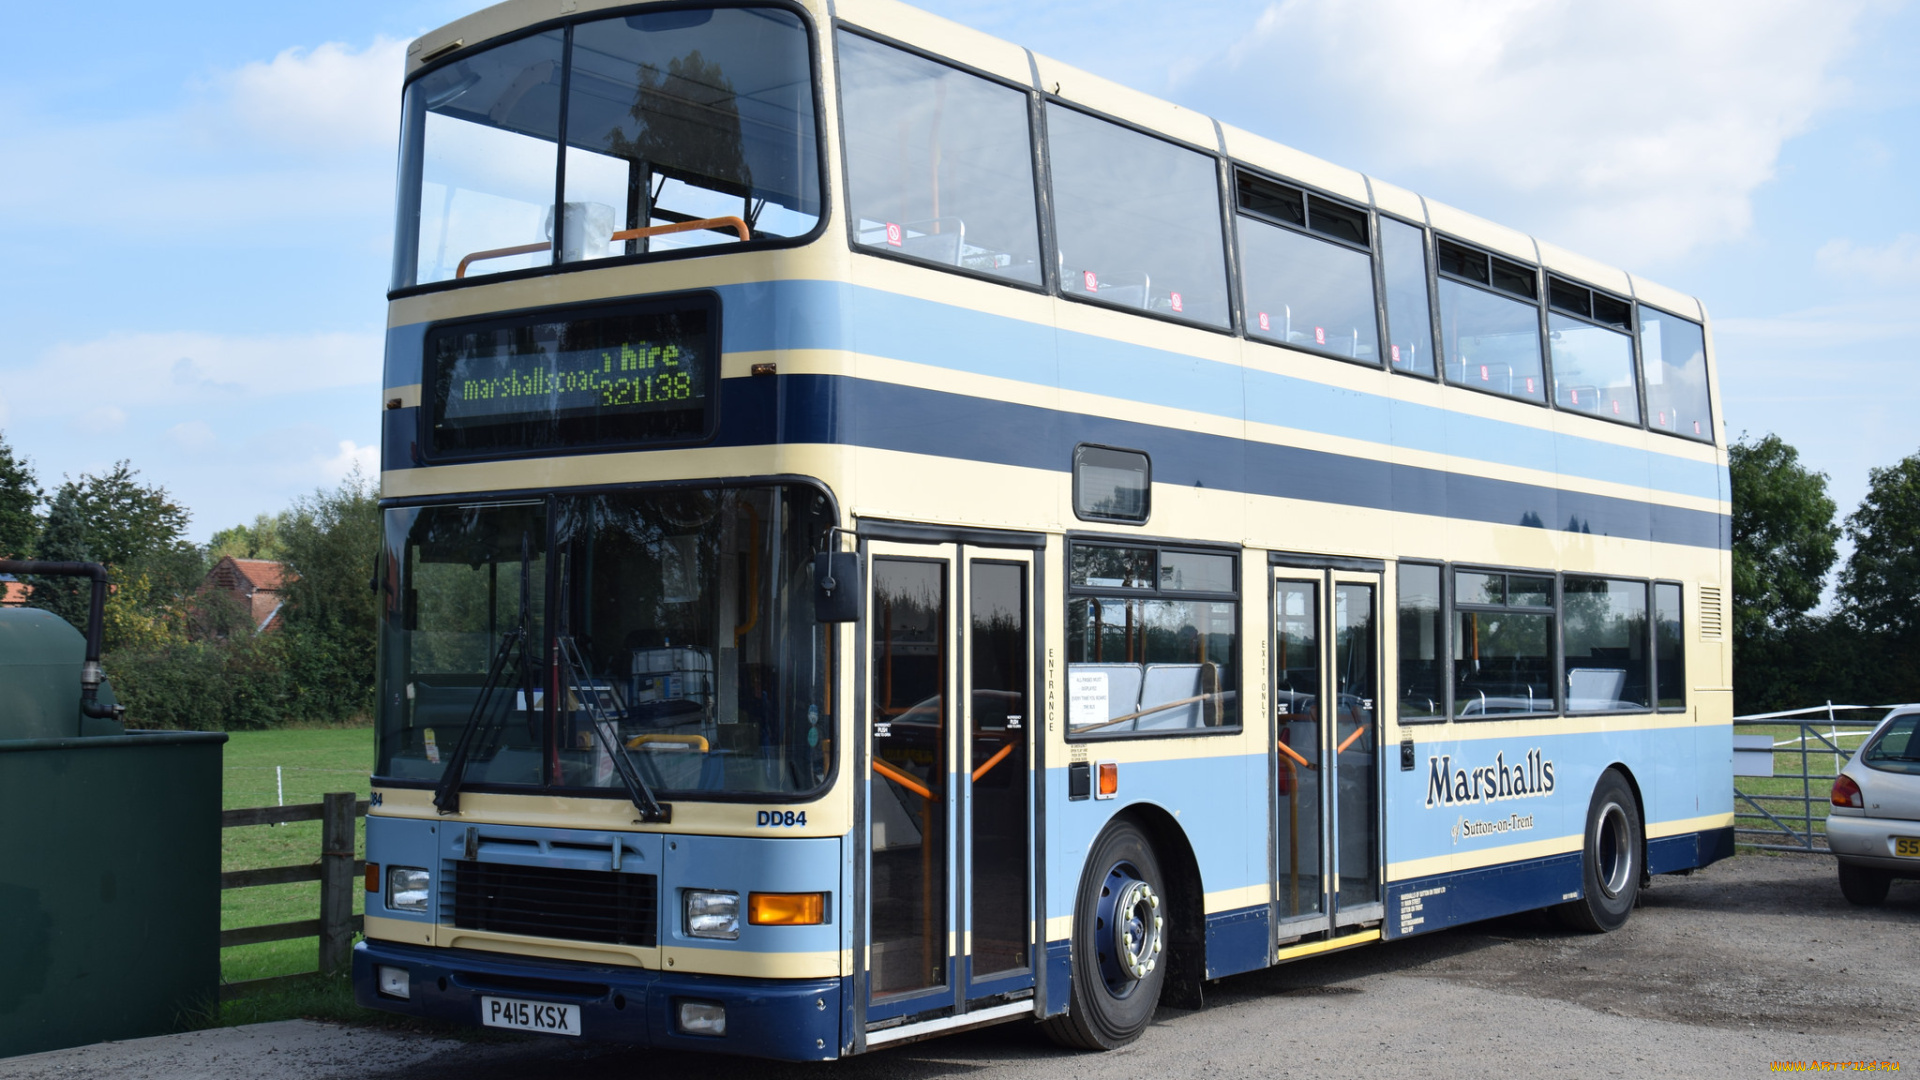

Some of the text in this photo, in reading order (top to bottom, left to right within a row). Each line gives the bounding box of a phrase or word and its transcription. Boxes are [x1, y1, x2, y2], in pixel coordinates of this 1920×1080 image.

[621, 341, 679, 371] hire
[600, 372, 690, 406] 321138
[1426, 748, 1554, 807] Marshalls
[757, 810, 807, 828] DD84
[1463, 813, 1534, 837] Sutton-on-Trent
[491, 1000, 568, 1030] P415 KSX
